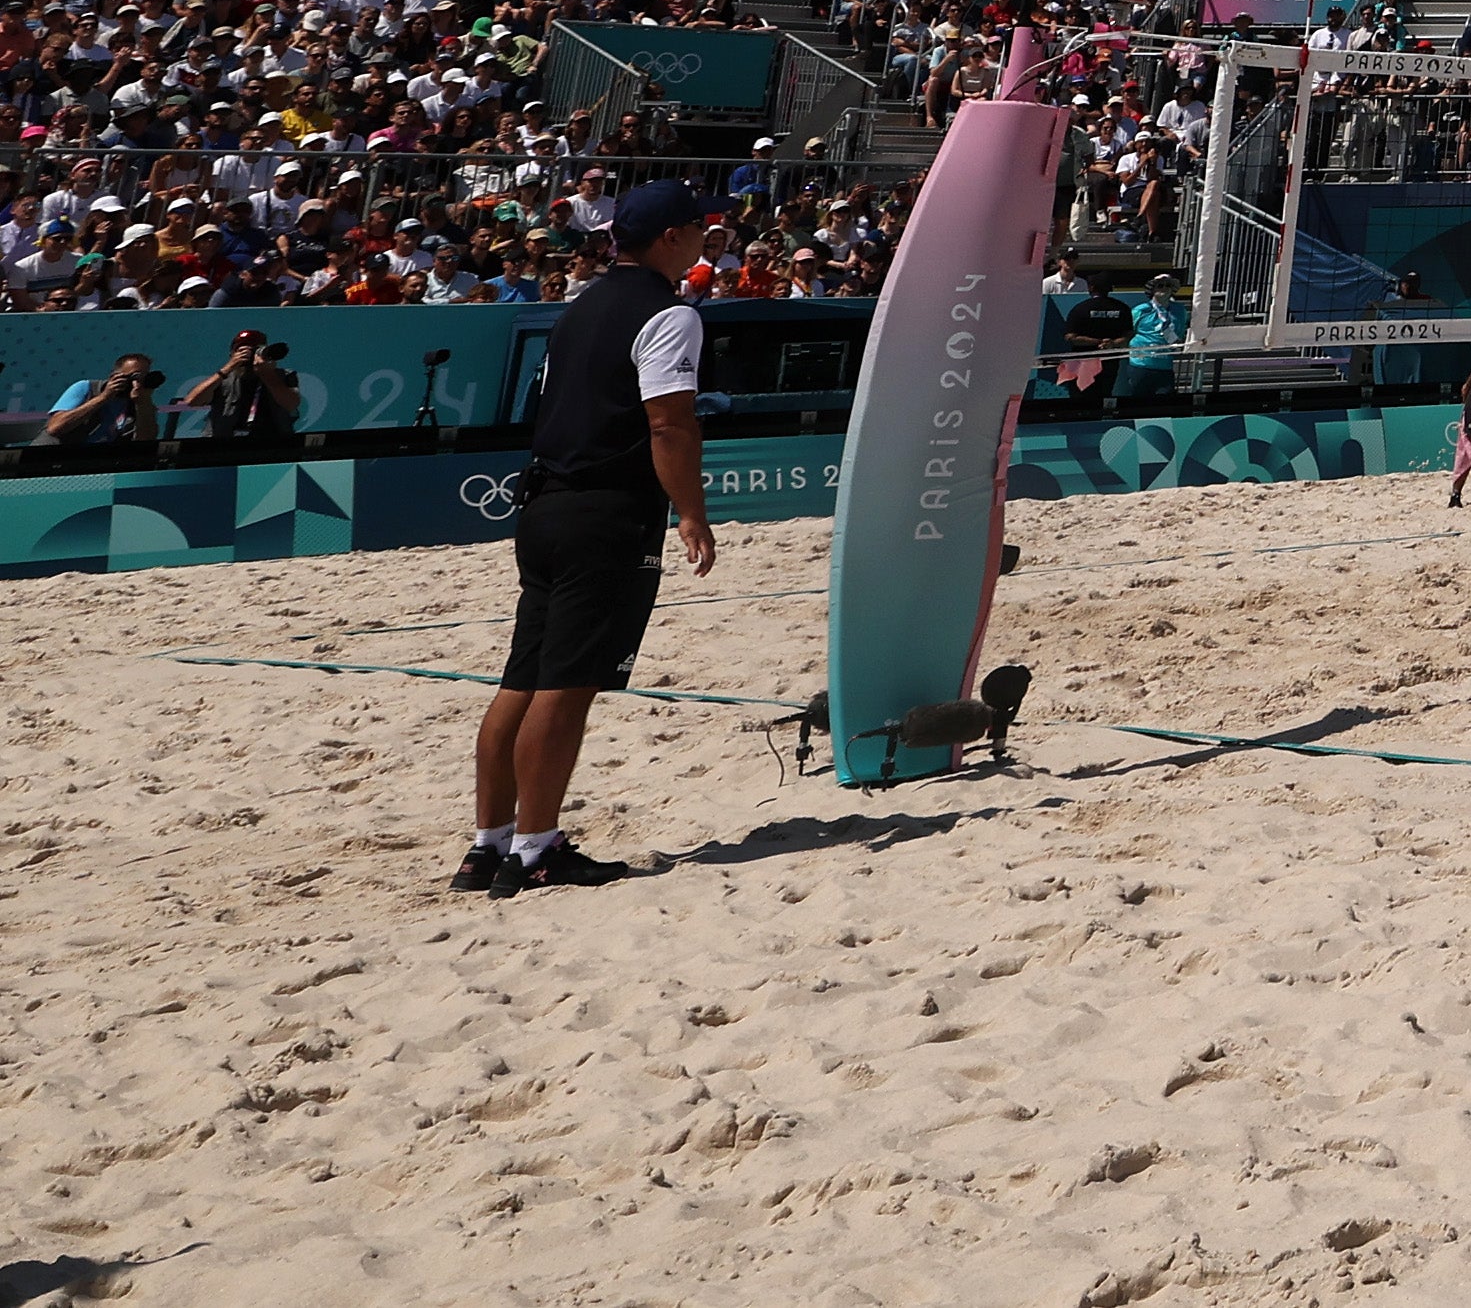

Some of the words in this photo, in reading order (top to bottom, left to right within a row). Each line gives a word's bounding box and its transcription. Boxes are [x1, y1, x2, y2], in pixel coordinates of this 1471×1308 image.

[1414, 57, 1467, 75] 2024
[940, 273, 987, 389] 2024
[1386, 324, 1442, 340] 2024
